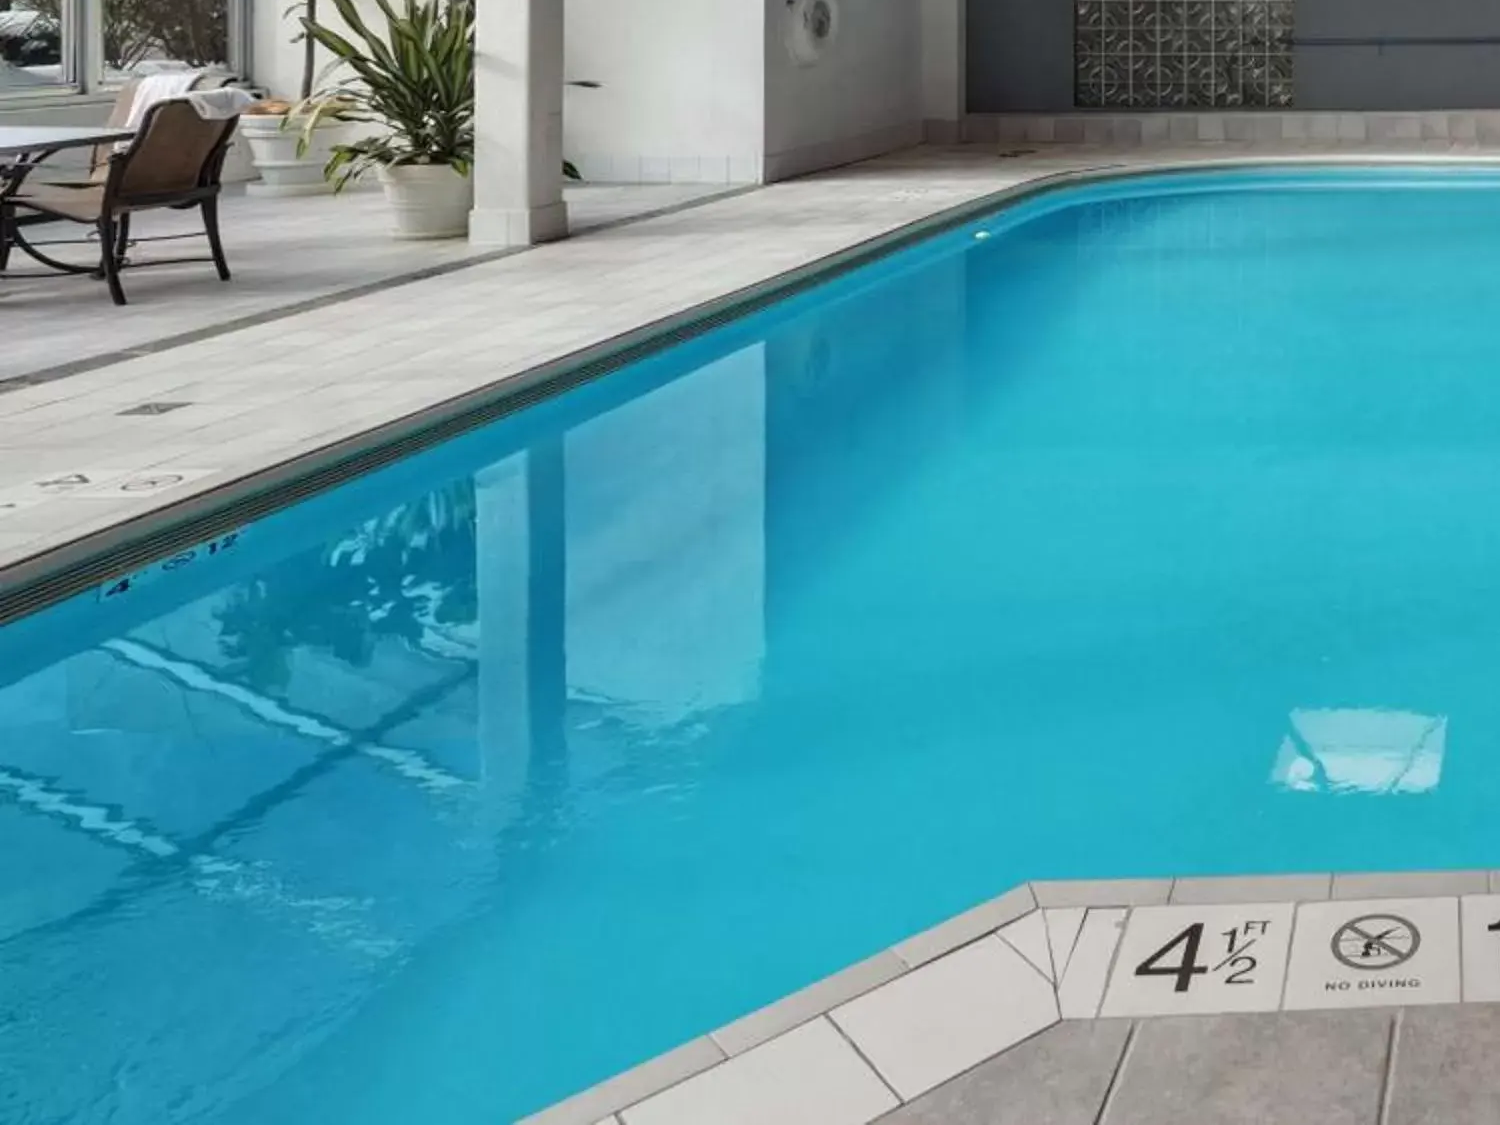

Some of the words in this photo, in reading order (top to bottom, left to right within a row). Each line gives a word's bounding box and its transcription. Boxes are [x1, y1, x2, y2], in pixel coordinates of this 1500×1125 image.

[1134, 922, 1208, 992] 4
[1243, 920, 1272, 936] FT
[1325, 980, 1351, 991] NO
[1358, 978, 1421, 991] DIVING
